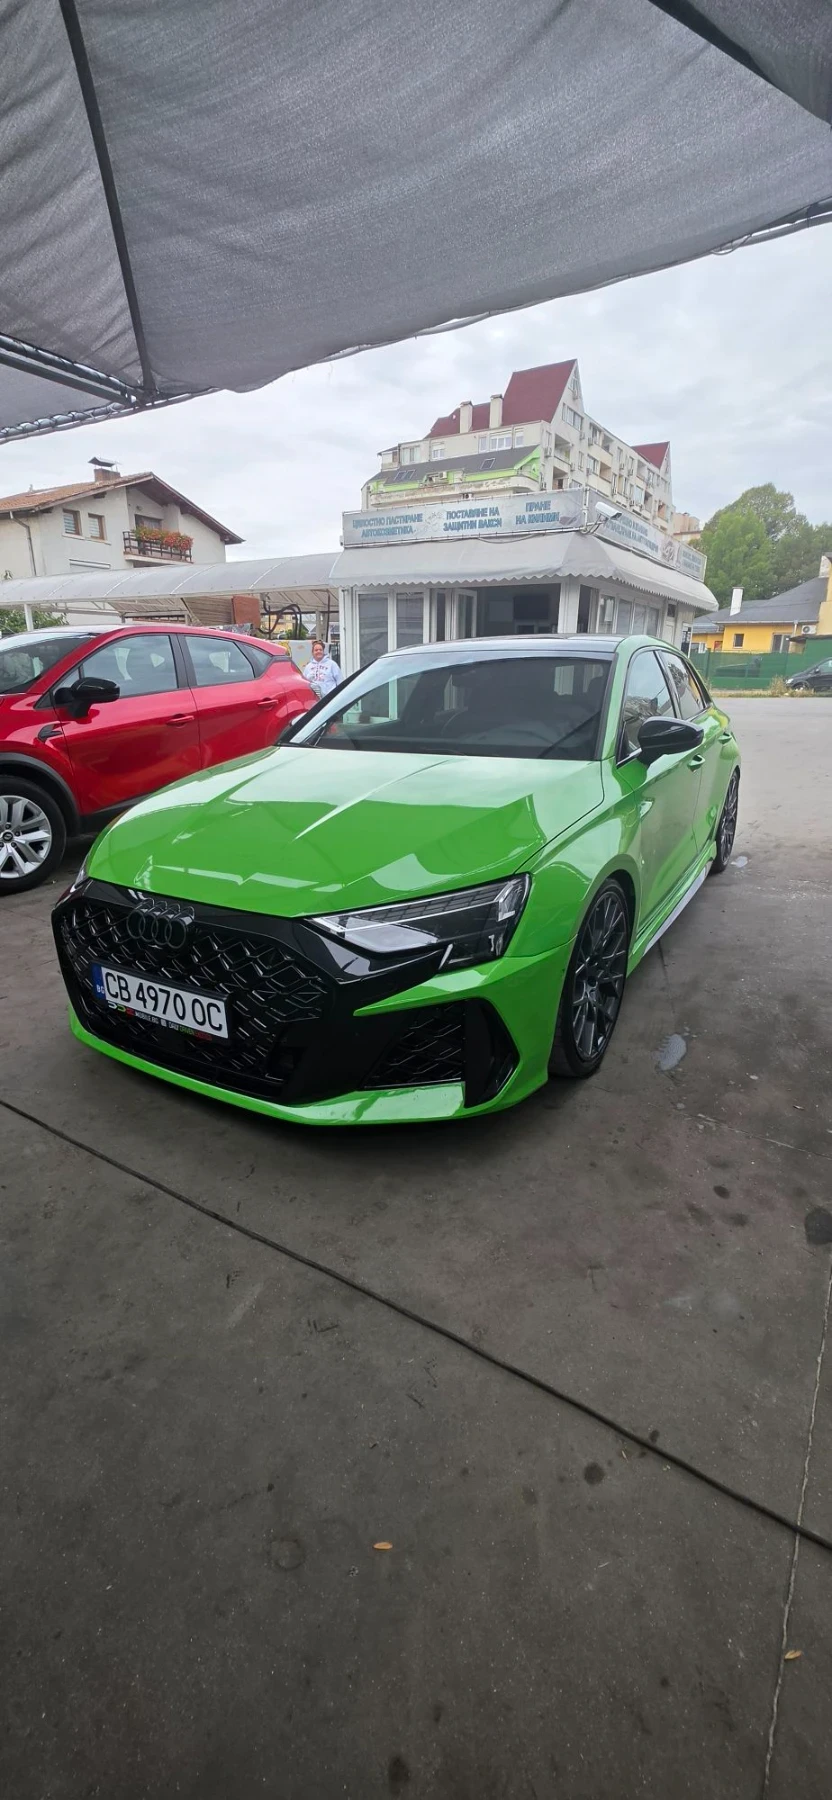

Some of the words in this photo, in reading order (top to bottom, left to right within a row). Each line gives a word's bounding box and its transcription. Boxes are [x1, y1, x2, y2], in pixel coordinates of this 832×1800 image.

[488, 506, 500, 516] НА
[515, 514, 528, 525] НА
[96, 984, 105, 995] BG
[105, 971, 131, 1003] CB
[135, 982, 186, 1020] 4970
[191, 998, 223, 1032] OC
